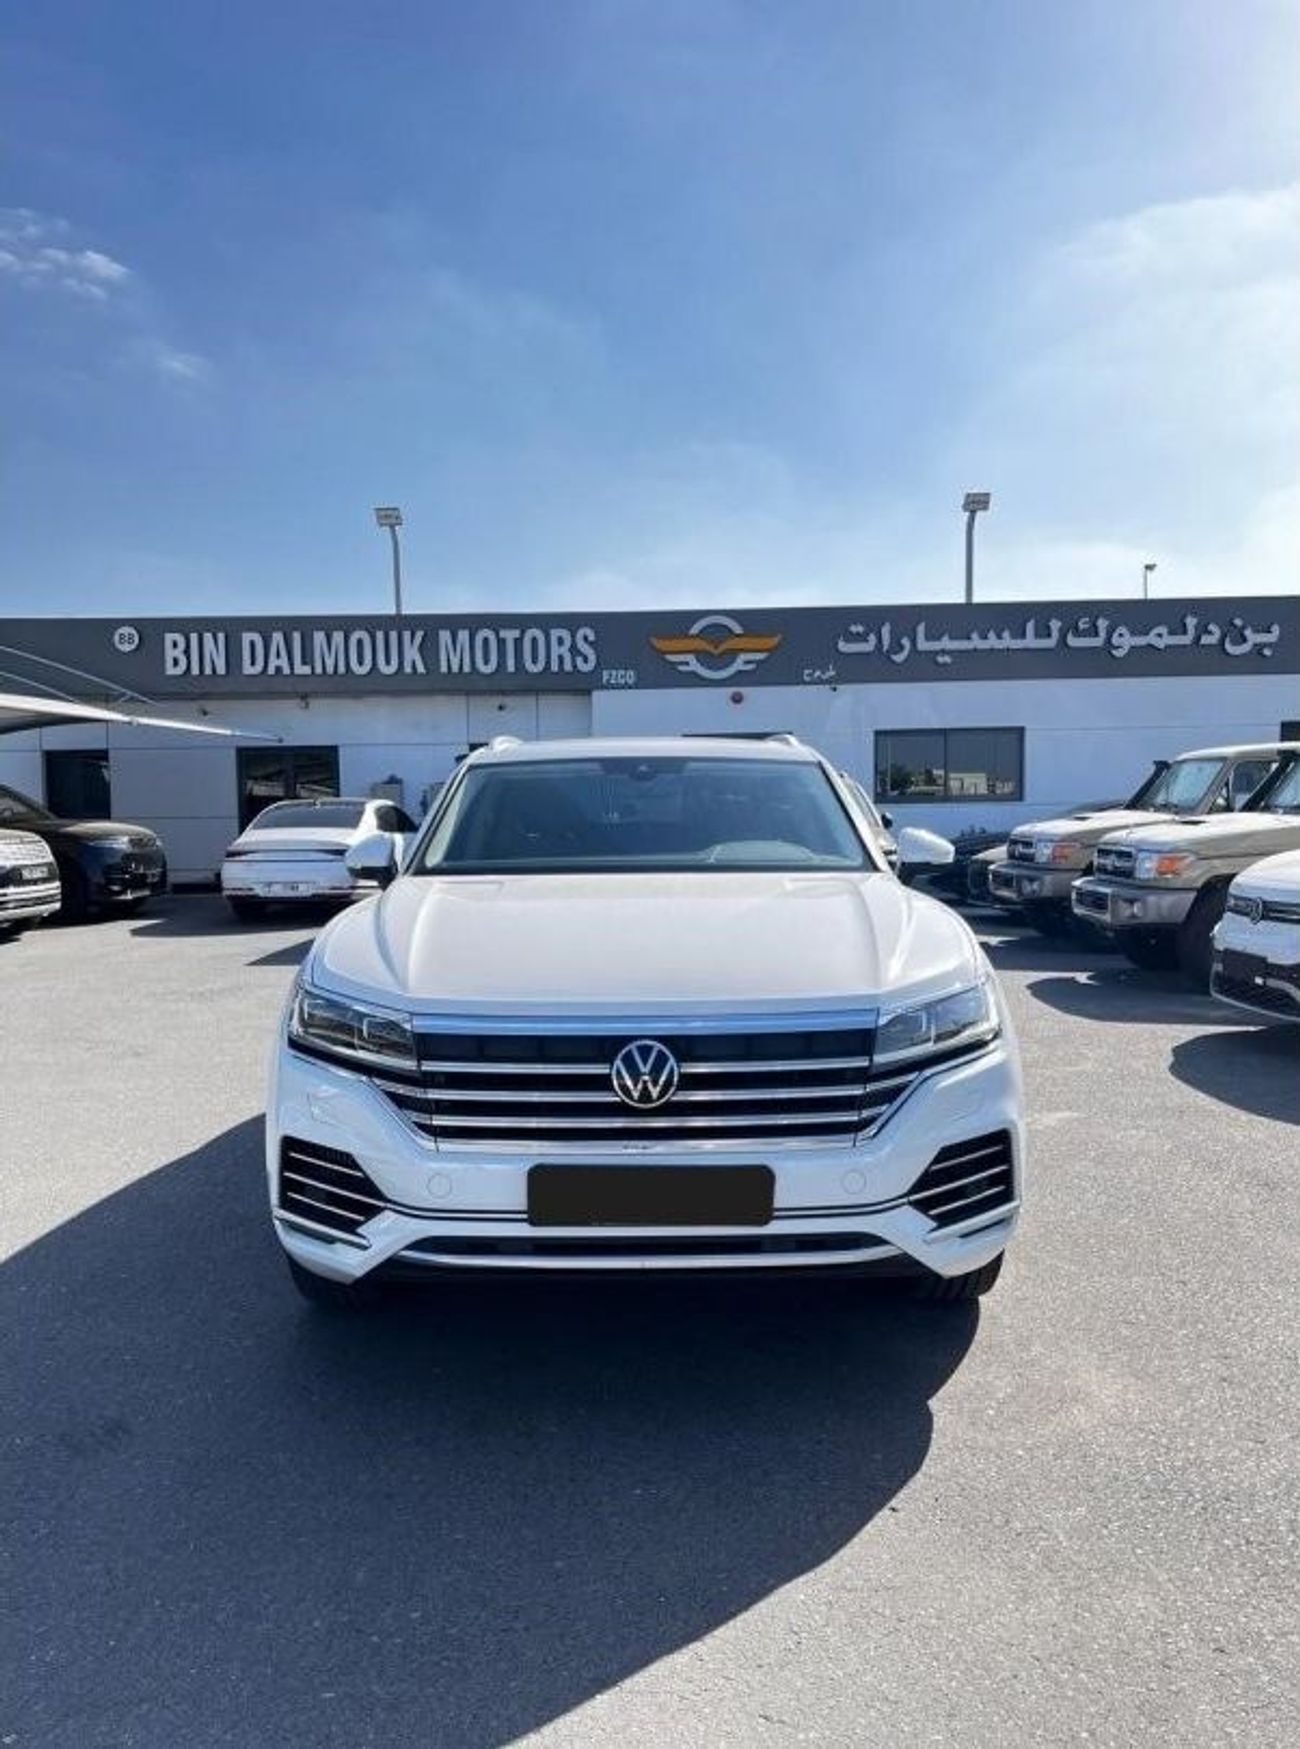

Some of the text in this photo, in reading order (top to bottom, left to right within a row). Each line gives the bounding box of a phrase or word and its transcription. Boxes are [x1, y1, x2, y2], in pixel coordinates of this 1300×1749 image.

[164, 626, 597, 676] BIN DALMOUK MOTORS
[837, 614, 1280, 664] بن دلموك للسيارات
